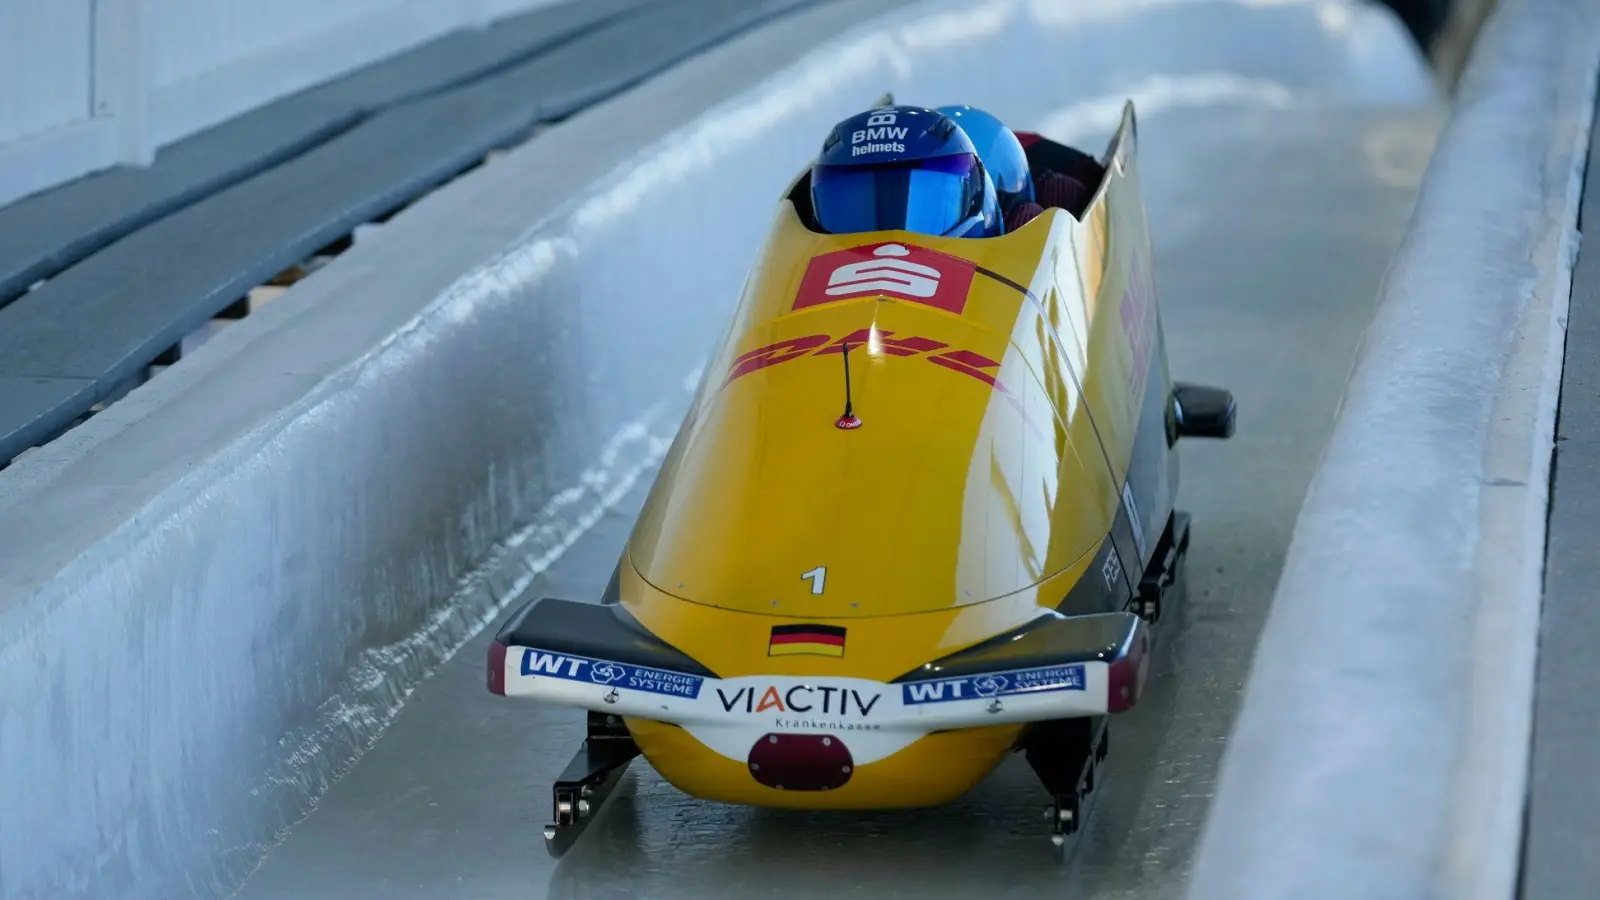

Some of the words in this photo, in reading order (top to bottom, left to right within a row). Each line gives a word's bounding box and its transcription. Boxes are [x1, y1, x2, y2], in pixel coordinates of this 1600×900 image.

[851, 127, 909, 144] BMW
[851, 142, 905, 157] helmets
[719, 328, 1008, 393] DHL
[801, 566, 827, 595] 1
[529, 652, 588, 677] WT
[1016, 668, 1078, 681] ENERGIE
[629, 676, 694, 696] SYSTEME
[634, 668, 695, 686] ENERGIE
[716, 685, 881, 716] VIACTIV
[908, 679, 968, 702] WT
[775, 717, 881, 731] Krankenkasse
